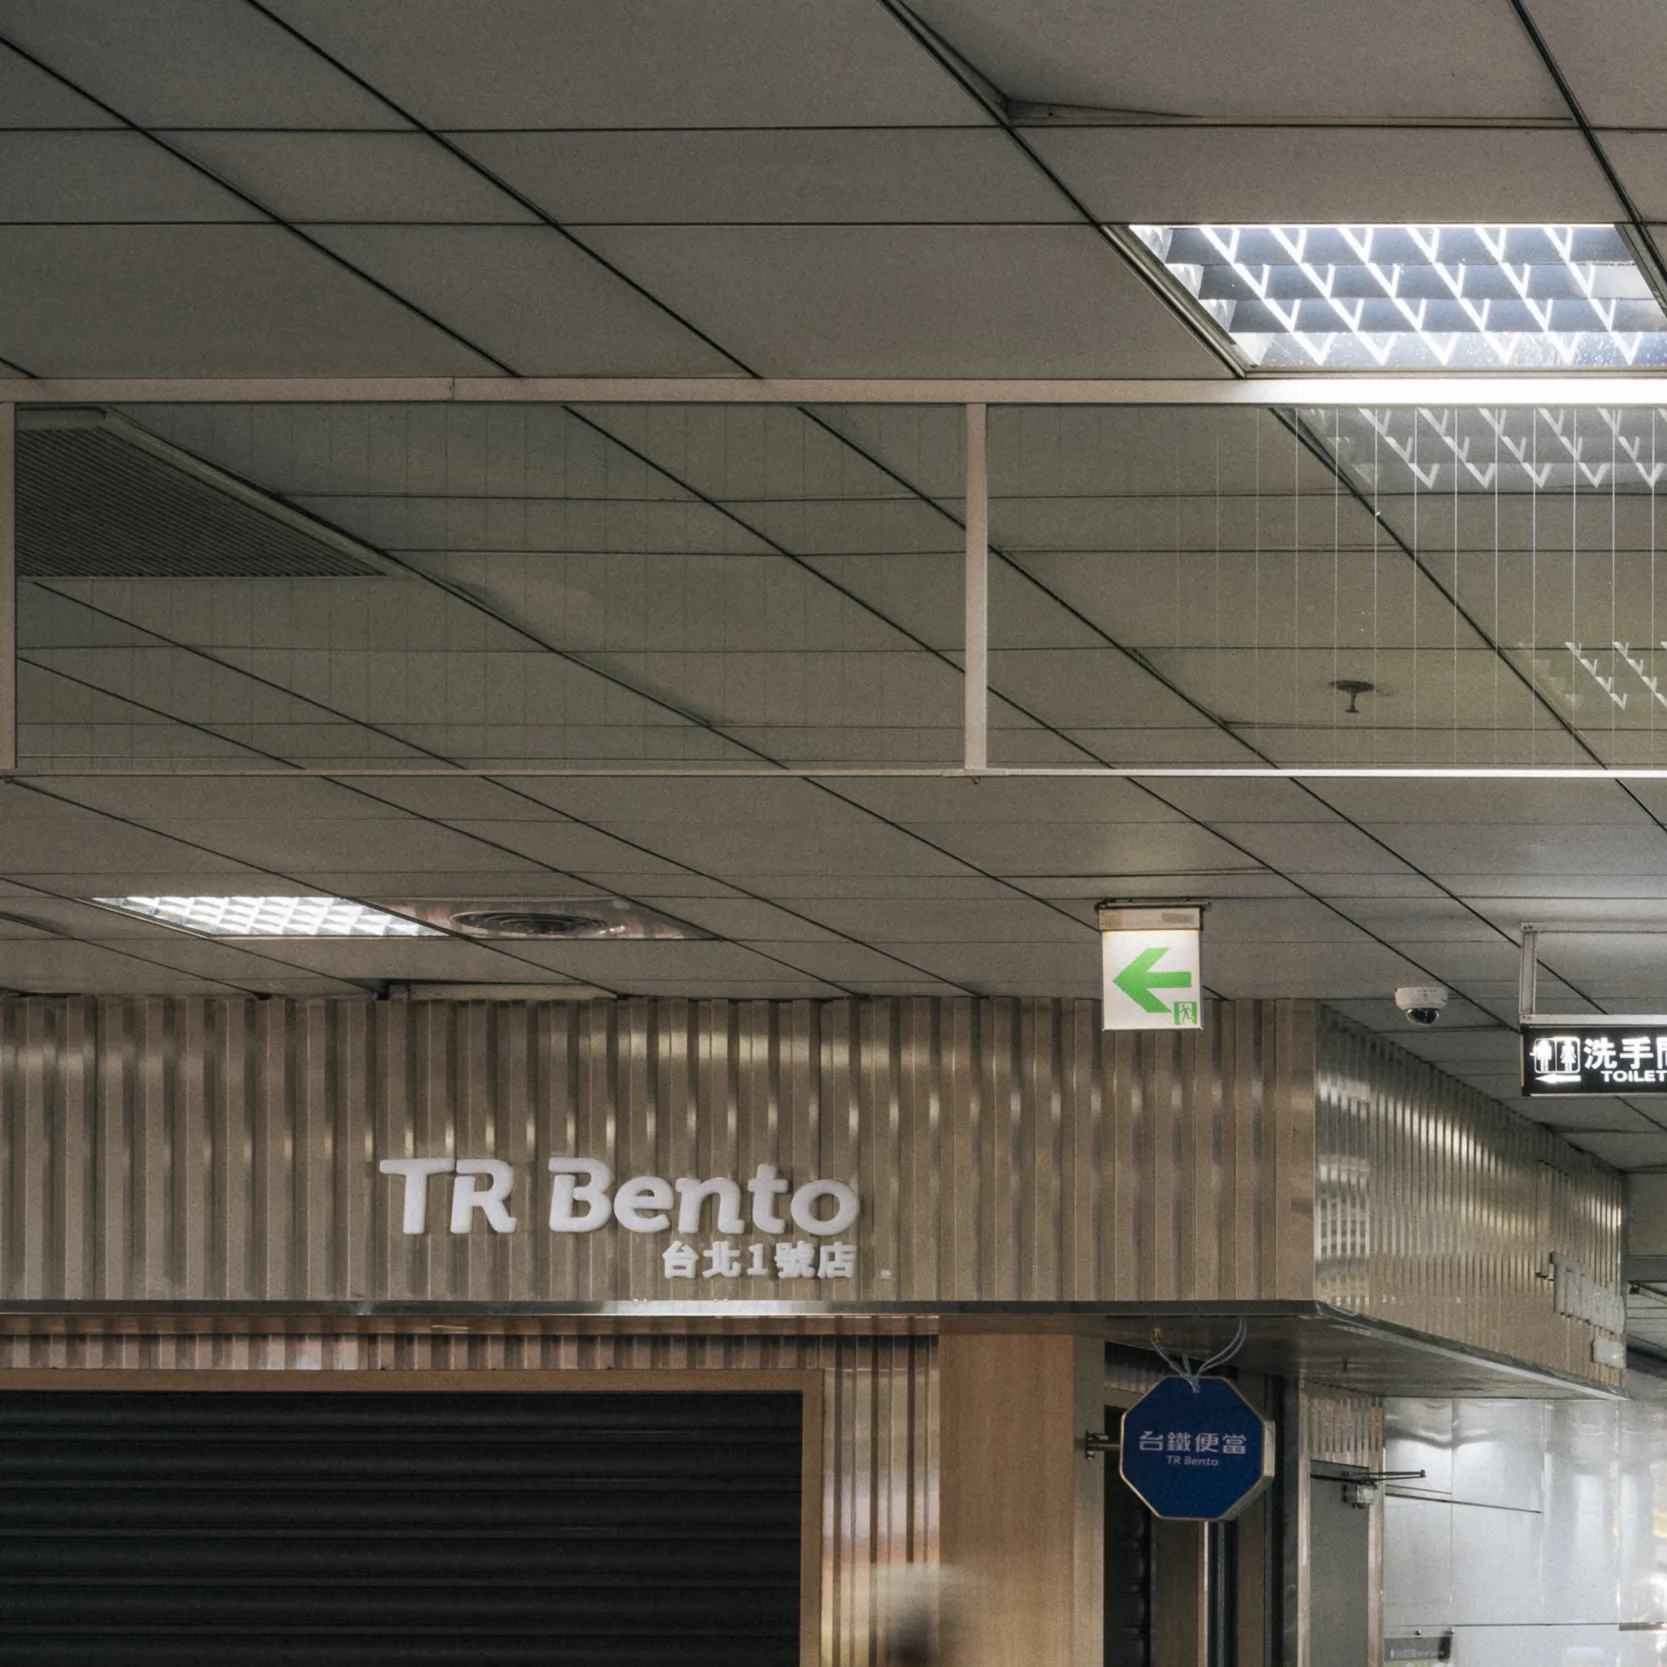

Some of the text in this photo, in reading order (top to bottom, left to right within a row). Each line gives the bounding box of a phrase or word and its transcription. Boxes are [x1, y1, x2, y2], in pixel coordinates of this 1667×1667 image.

[379, 1157, 861, 1237] TR Bento
[662, 1240, 858, 1279] 台北1號店
[1138, 1431, 1248, 1455] 台鐵便當
[1165, 1455, 1219, 1467] TR Bento
